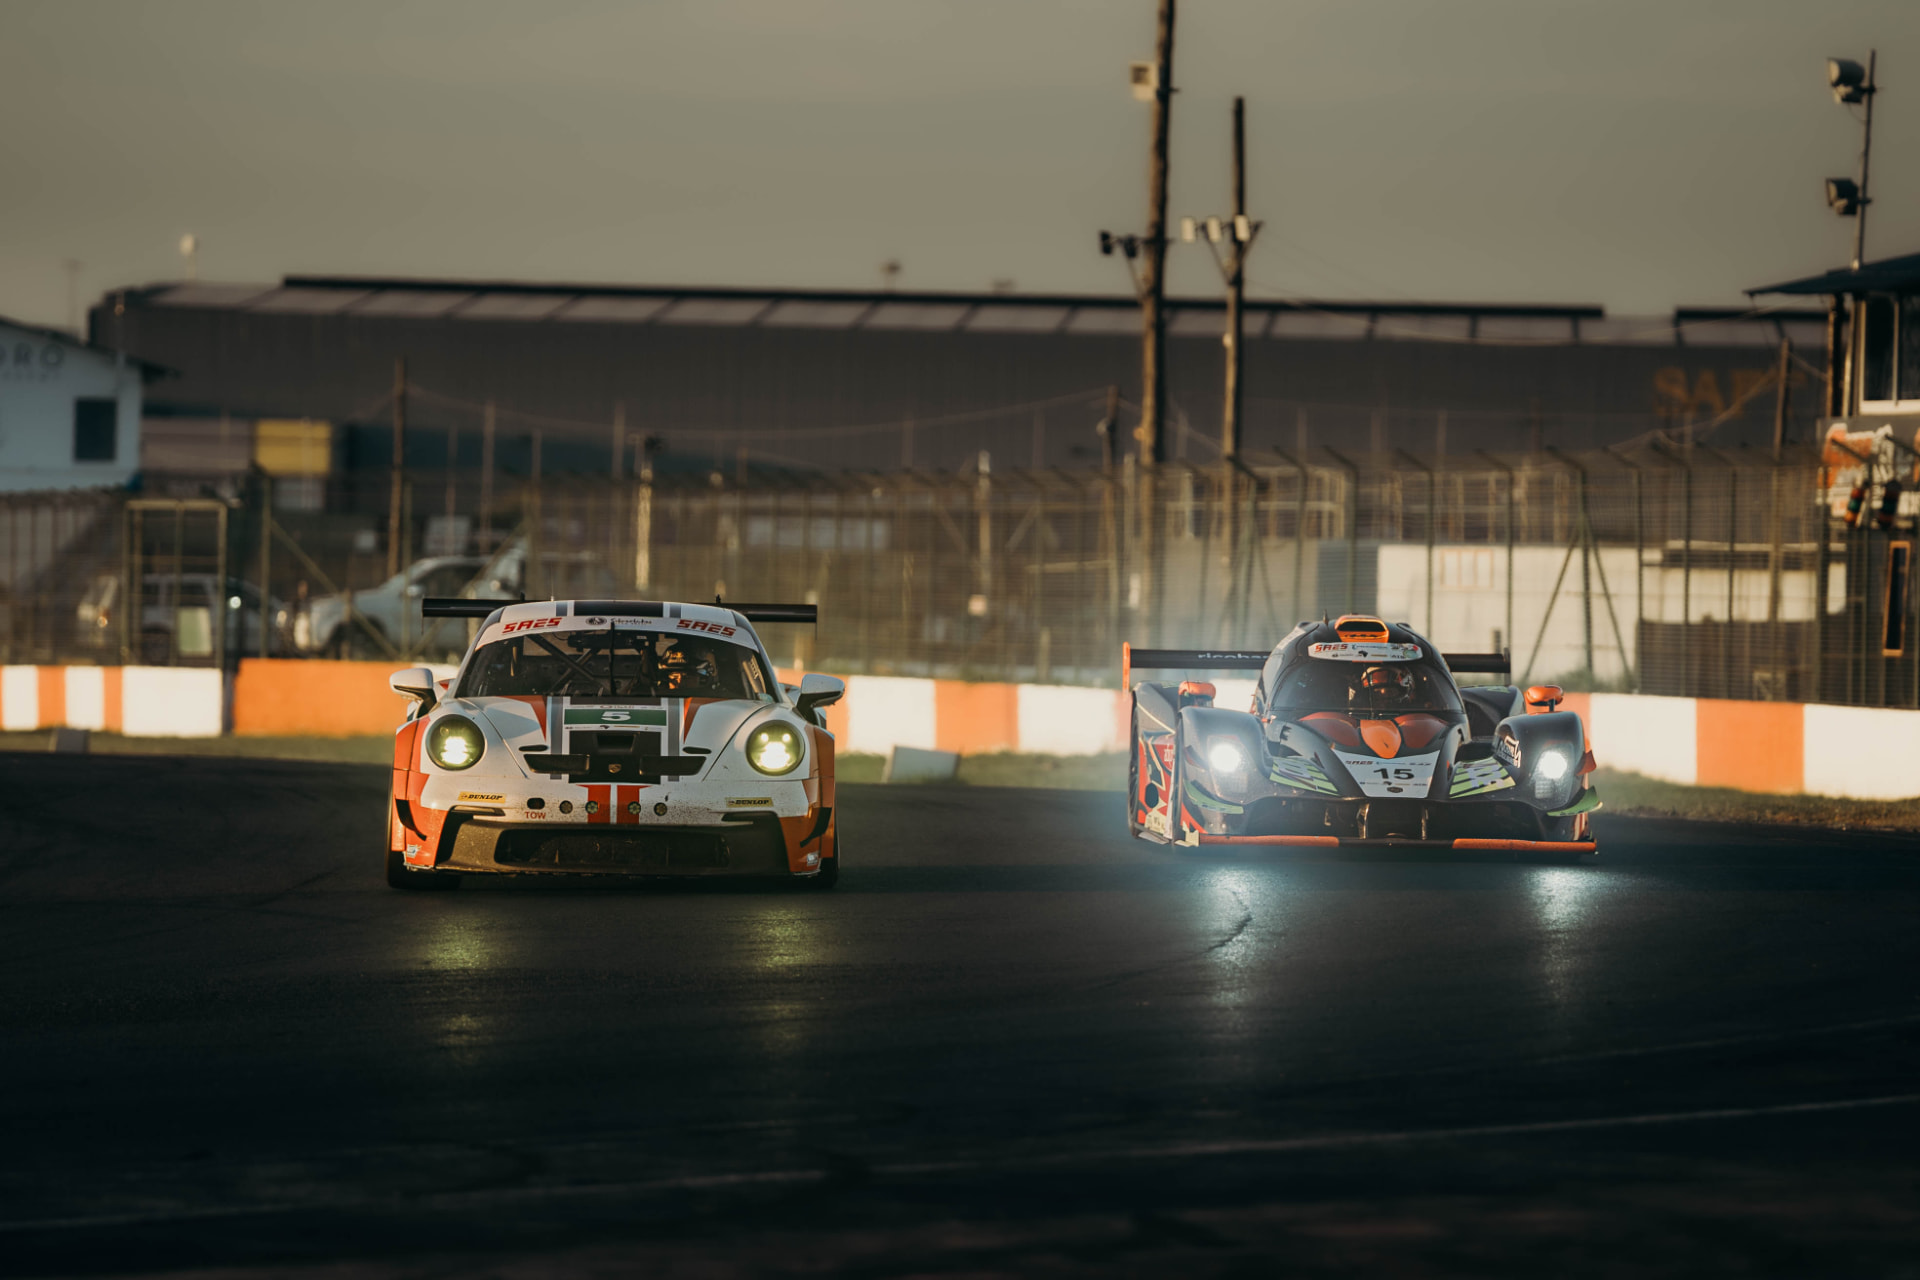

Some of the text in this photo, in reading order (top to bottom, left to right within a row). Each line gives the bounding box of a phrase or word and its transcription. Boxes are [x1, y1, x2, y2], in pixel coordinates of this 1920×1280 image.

[502, 617, 563, 633] SAES
[676, 619, 737, 637] SAES
[1314, 643, 1349, 653] SAES
[600, 711, 632, 722] 5
[1373, 767, 1415, 780] 15
[524, 811, 547, 819] TOW
